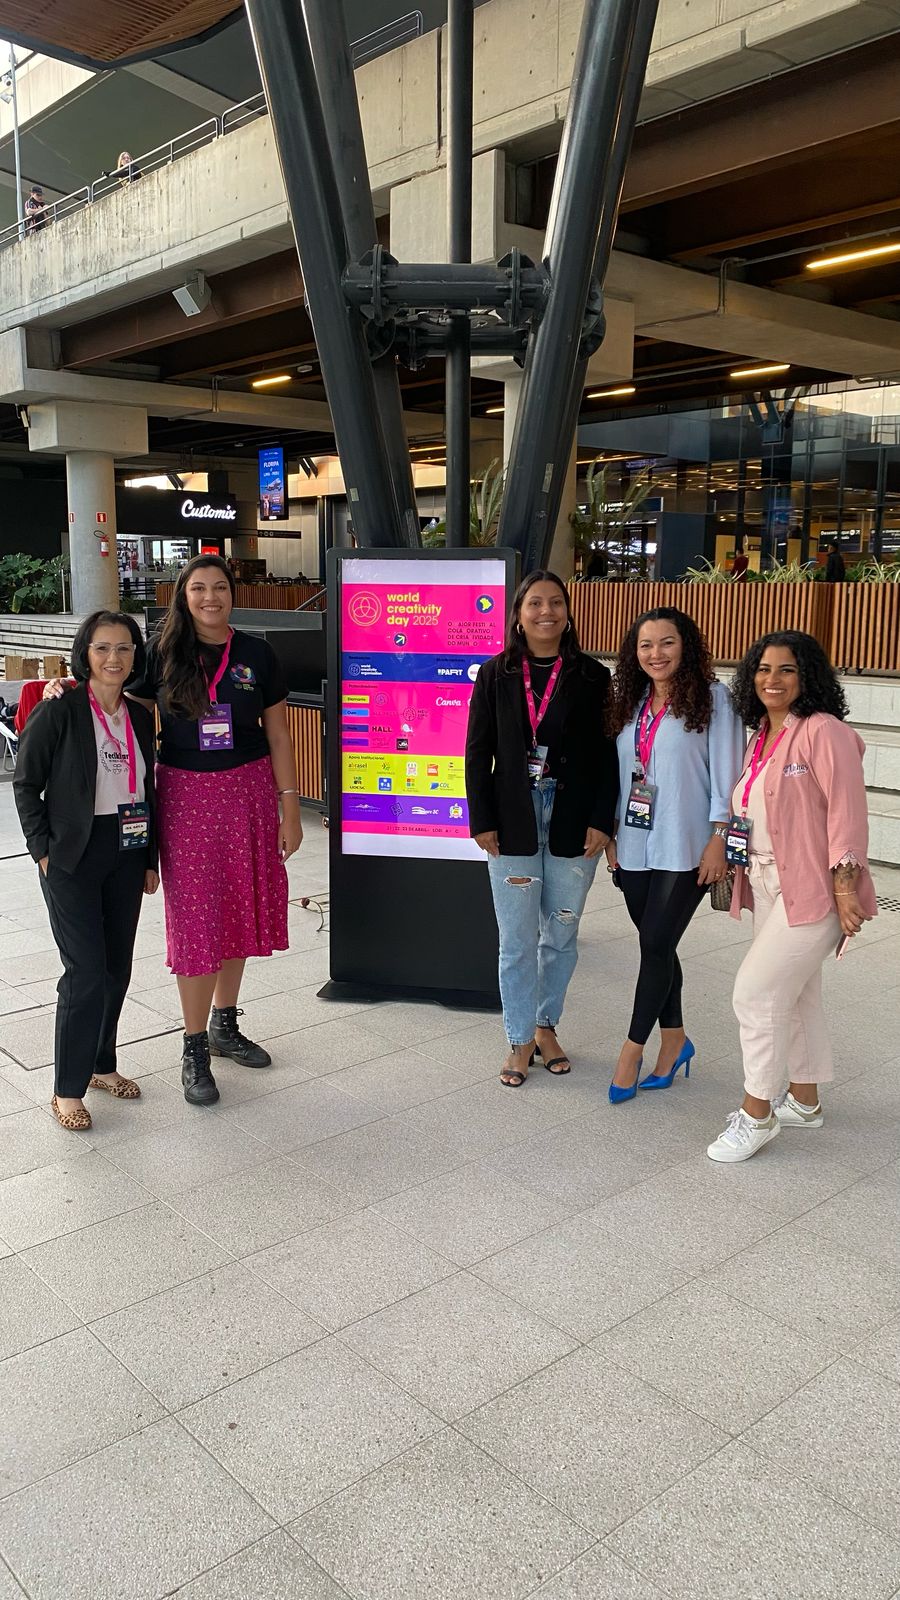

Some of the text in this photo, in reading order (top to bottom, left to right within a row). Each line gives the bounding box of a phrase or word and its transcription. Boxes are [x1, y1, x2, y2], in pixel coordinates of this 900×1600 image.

[263, 460, 280, 468] FLORIPA
[181, 499, 237, 520] Customix
[386, 592, 420, 603] world
[386, 603, 442, 617] creativity
[386, 614, 439, 627] day 2025
[435, 696, 462, 707] Canva
